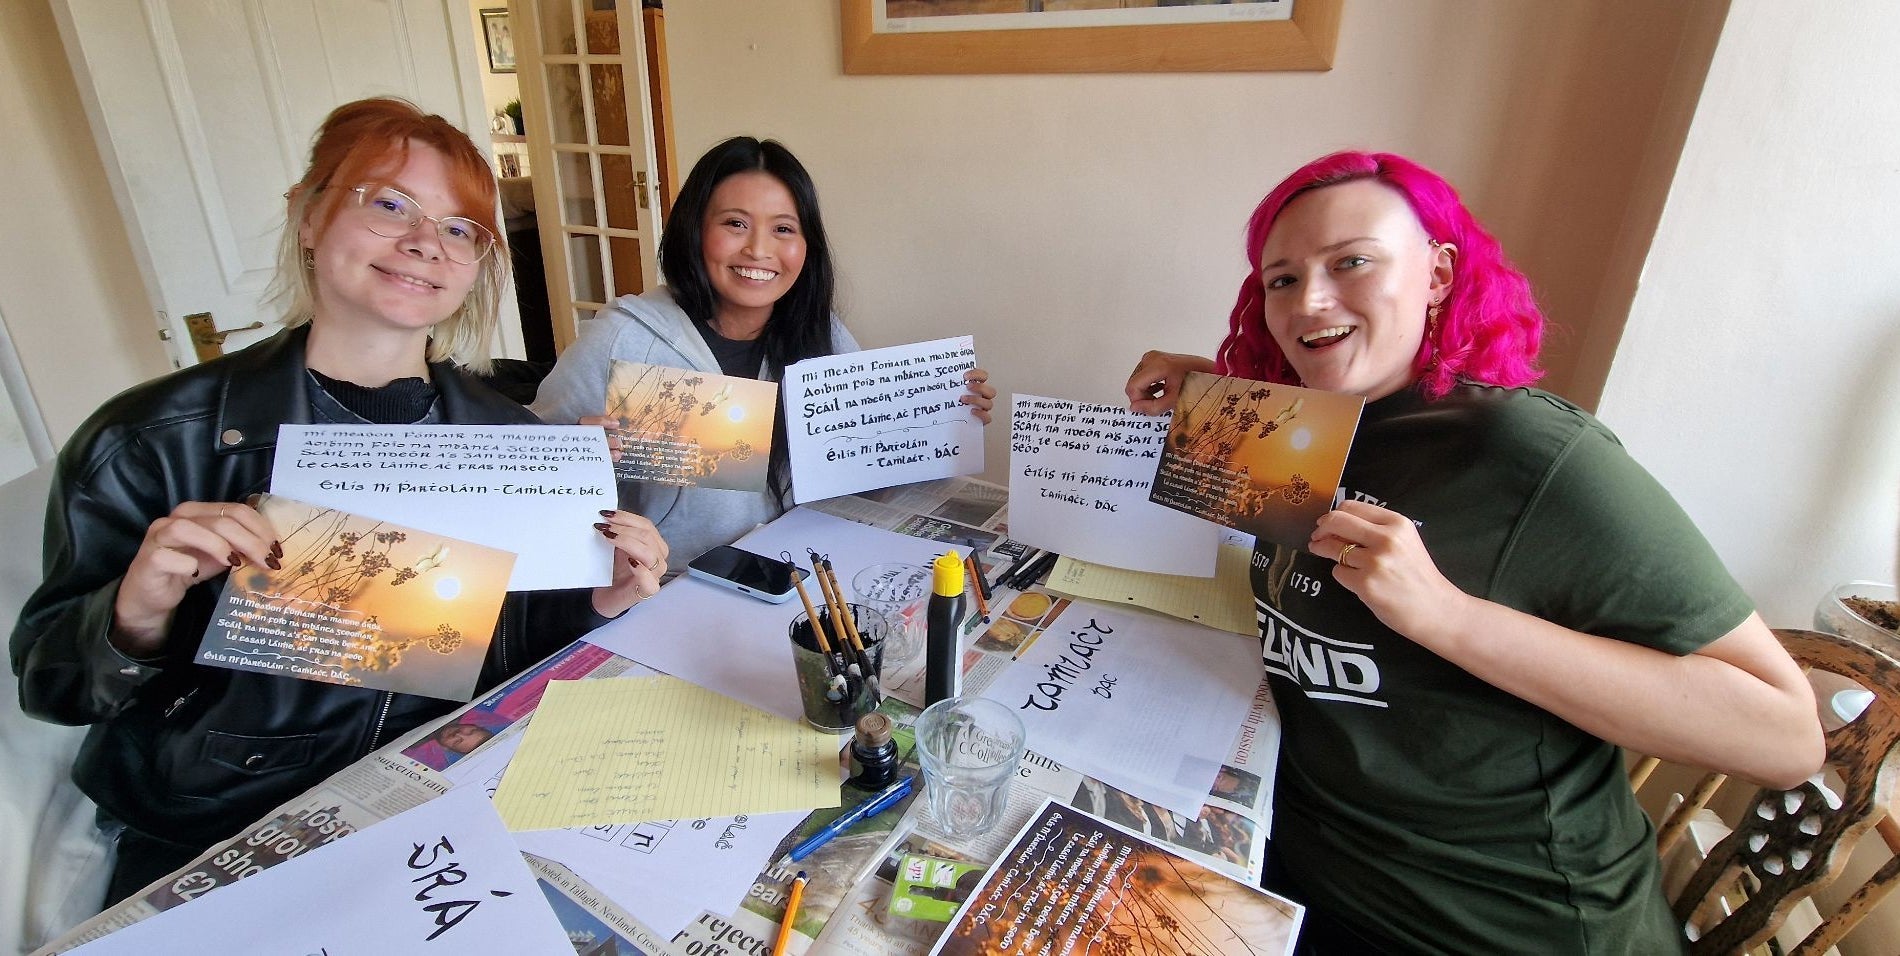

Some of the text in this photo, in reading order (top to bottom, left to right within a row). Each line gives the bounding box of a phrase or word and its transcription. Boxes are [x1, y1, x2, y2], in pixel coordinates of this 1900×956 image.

[1290, 571, 1322, 597] 1759
[1234, 723, 1257, 765] passion
[561, 879, 570, 889] in
[600, 905, 637, 937] Newlands
[636, 932, 660, 954] Cross
